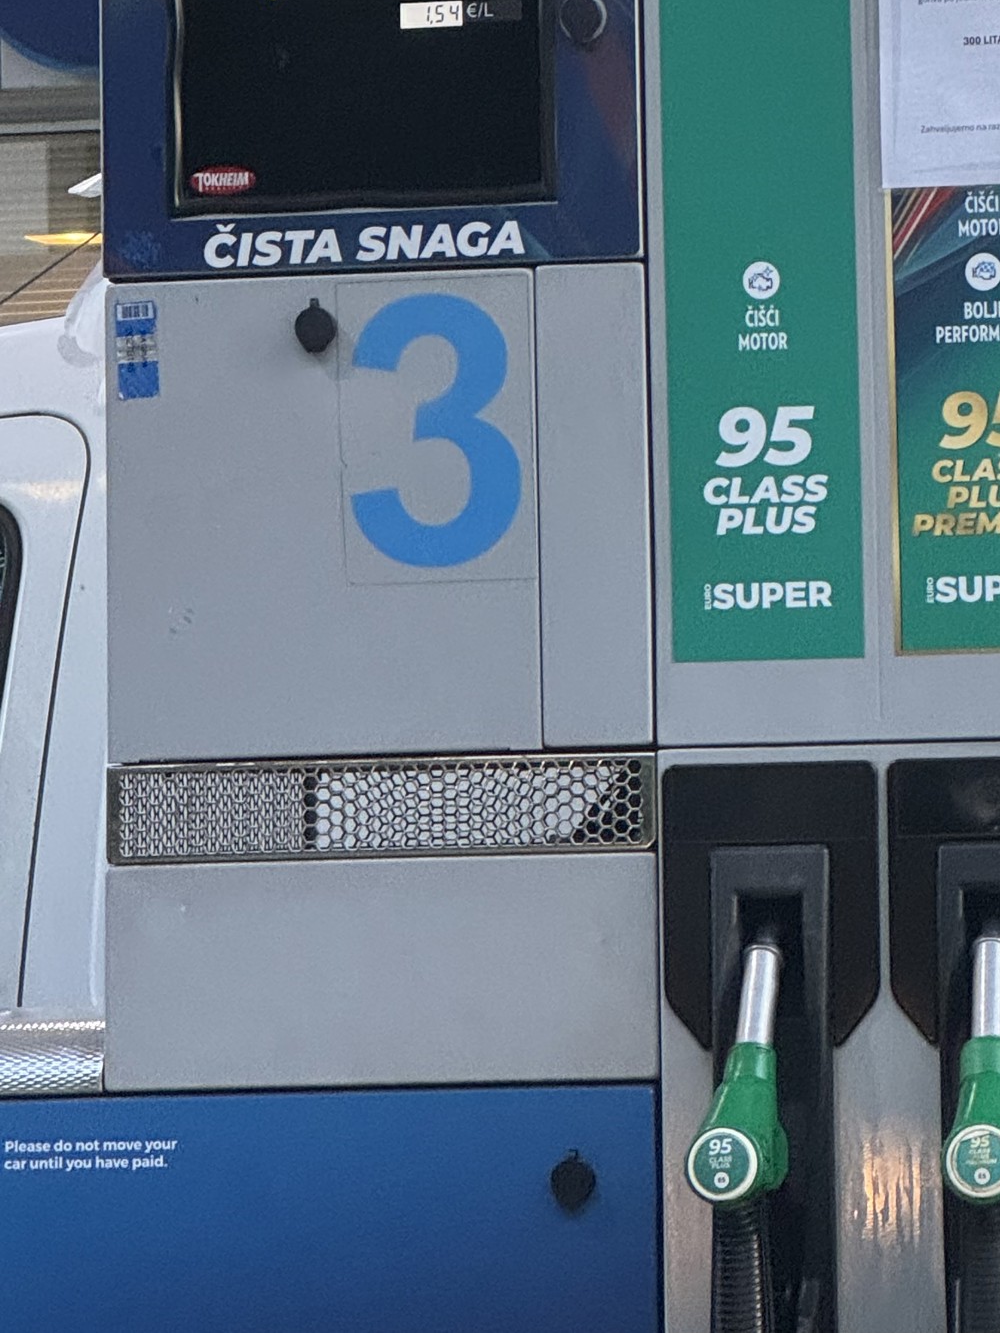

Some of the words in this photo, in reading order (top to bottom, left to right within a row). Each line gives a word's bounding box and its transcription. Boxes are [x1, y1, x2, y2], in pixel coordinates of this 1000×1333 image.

[425, 4, 461, 25] 1,54
[466, 3, 494, 18] €/L
[963, 35, 982, 46] 300
[192, 171, 250, 193] TOKHEIM
[964, 190, 1000, 214] ČIŠĆI
[203, 223, 343, 268] ČISTA
[356, 219, 526, 262] SNAGA
[745, 306, 780, 328] ČIŠĆI
[738, 332, 788, 351] MOTOR
[350, 292, 522, 568] 3
[715, 405, 815, 468] 95
[703, 473, 829, 506] CLASS
[716, 505, 816, 536] PLUS
[704, 583, 712, 611] EURO
[712, 580, 832, 611] SUPER
[926, 576, 935, 603] EURO
[4, 1139, 50, 1152] Please
[53, 1139, 73, 1152] do
[75, 1140, 100, 1151] not
[103, 1141, 142, 1151] move
[144, 1139, 178, 1154] your
[708, 1138, 733, 1156] 95
[4, 1159, 27, 1170] car
[30, 1156, 63, 1169] until
[66, 1159, 92, 1172] you
[95, 1156, 129, 1168] have
[131, 1155, 168, 1170] paid.
